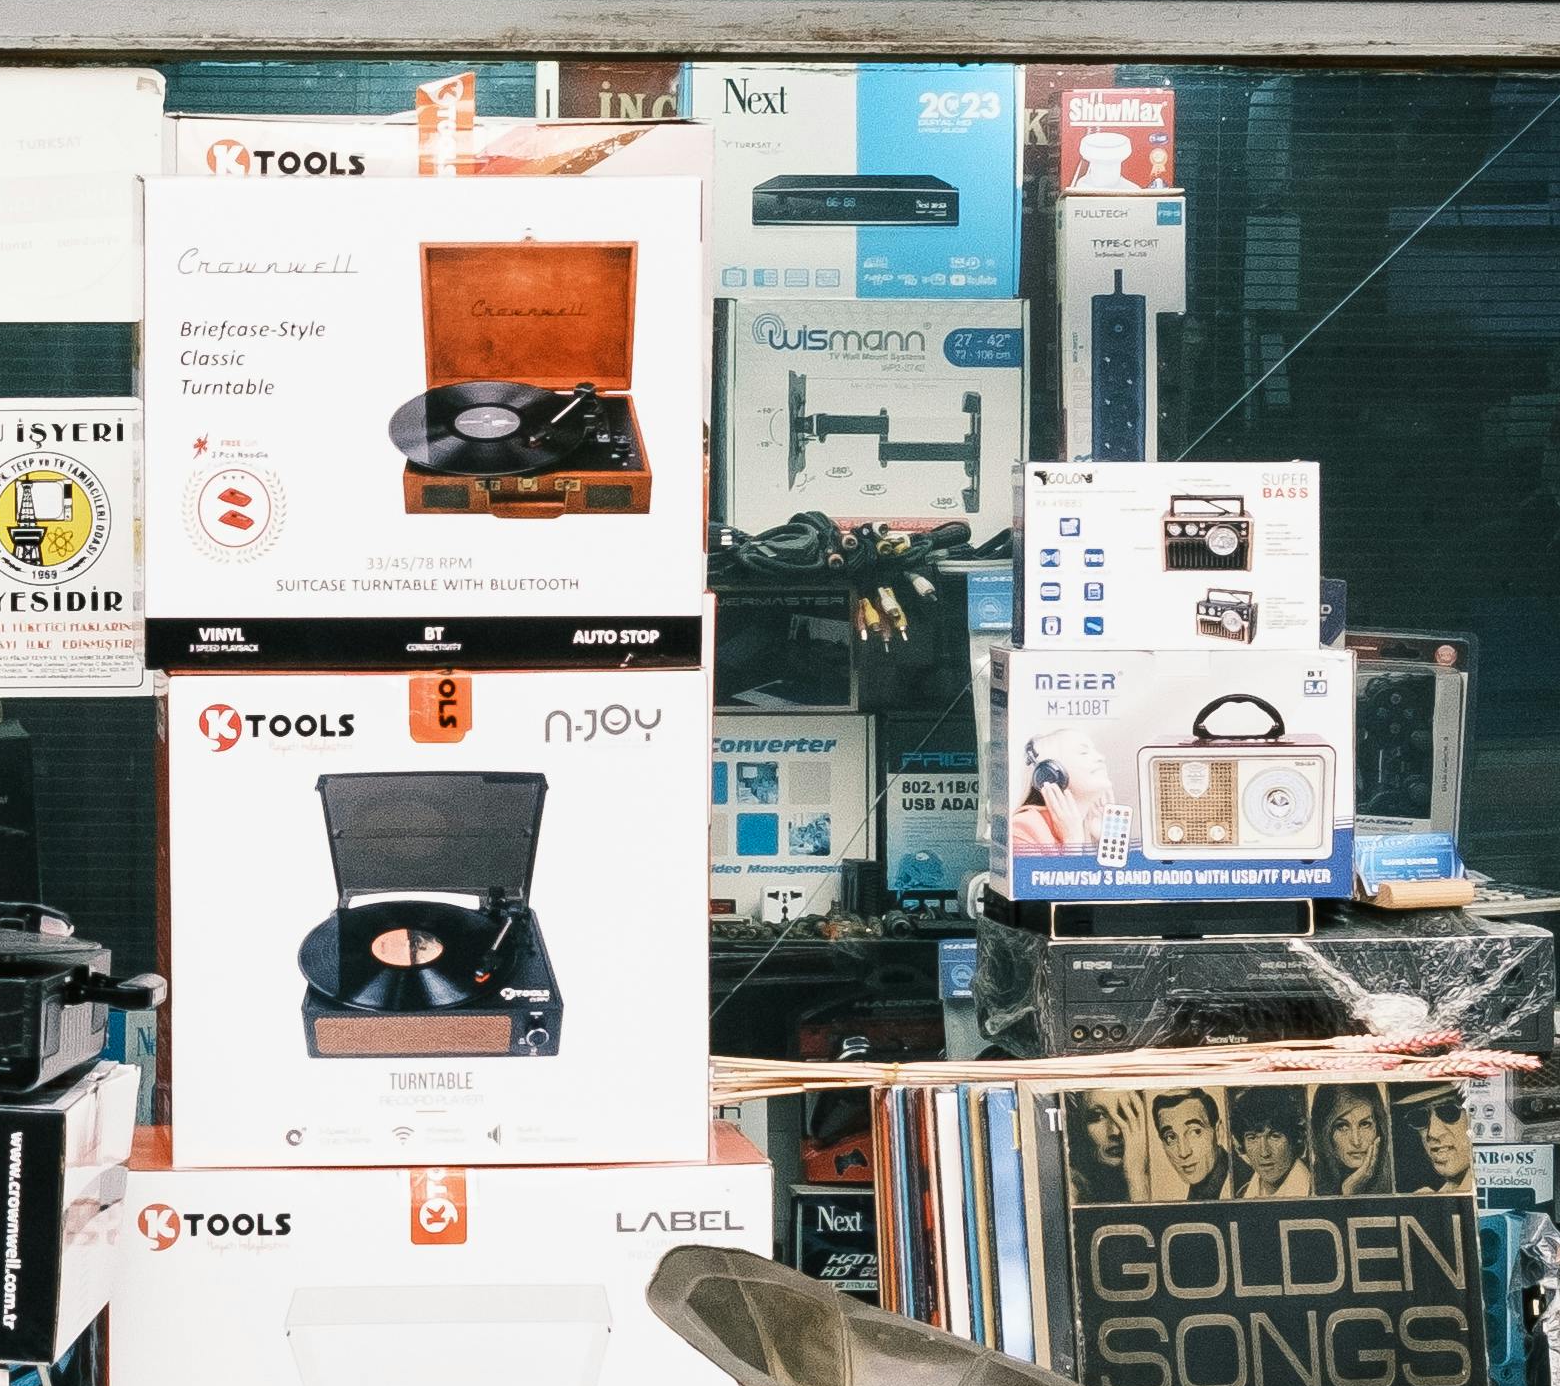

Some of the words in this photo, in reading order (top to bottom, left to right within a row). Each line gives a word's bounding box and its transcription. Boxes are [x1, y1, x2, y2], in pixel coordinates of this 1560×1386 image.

[722, 76, 789, 115] Next
[1068, 95, 1168, 124] ShowMax
[1074, 208, 1128, 219] FULLTECH
[1090, 238, 1131, 250] TYPE-C
[1132, 238, 1160, 250] PORT
[179, 319, 327, 342] Briefcase-Style
[179, 349, 247, 367] Classic
[181, 378, 275, 396] Turntable
[16, 416, 125, 450] İŞYERİ
[1261, 472, 1309, 486] SUPER
[1262, 486, 1309, 499] BASS
[438, 556, 475, 570] RPM
[275, 577, 347, 593] SUITCASE
[351, 577, 439, 593] TURNTABLE
[442, 577, 486, 592] WITH
[489, 576, 581, 592] BLUETOOTH
[198, 626, 246, 644] VINYL
[424, 625, 444, 643] BT
[572, 628, 617, 645] AUTO
[618, 628, 661, 646] STOP
[1034, 671, 1117, 691] MEIER
[1304, 680, 1328, 696] 5.0
[1046, 697, 1111, 718] M-110BT
[901, 796, 936, 811] USB
[1030, 867, 1102, 887] FM/AM/SW
[1102, 868, 1114, 886] 3
[1114, 868, 1152, 886] BAND
[1153, 868, 1193, 886] RADIO
[1194, 868, 1229, 885] WITH
[1231, 868, 1279, 885] USB/TF
[1280, 867, 1332, 886] PLAYER
[389, 1071, 474, 1091] TURNTABLE
[615, 1210, 746, 1234] LABEL
[816, 1205, 863, 1232] Next
[1089, 1213, 1468, 1304] GOLDEN
